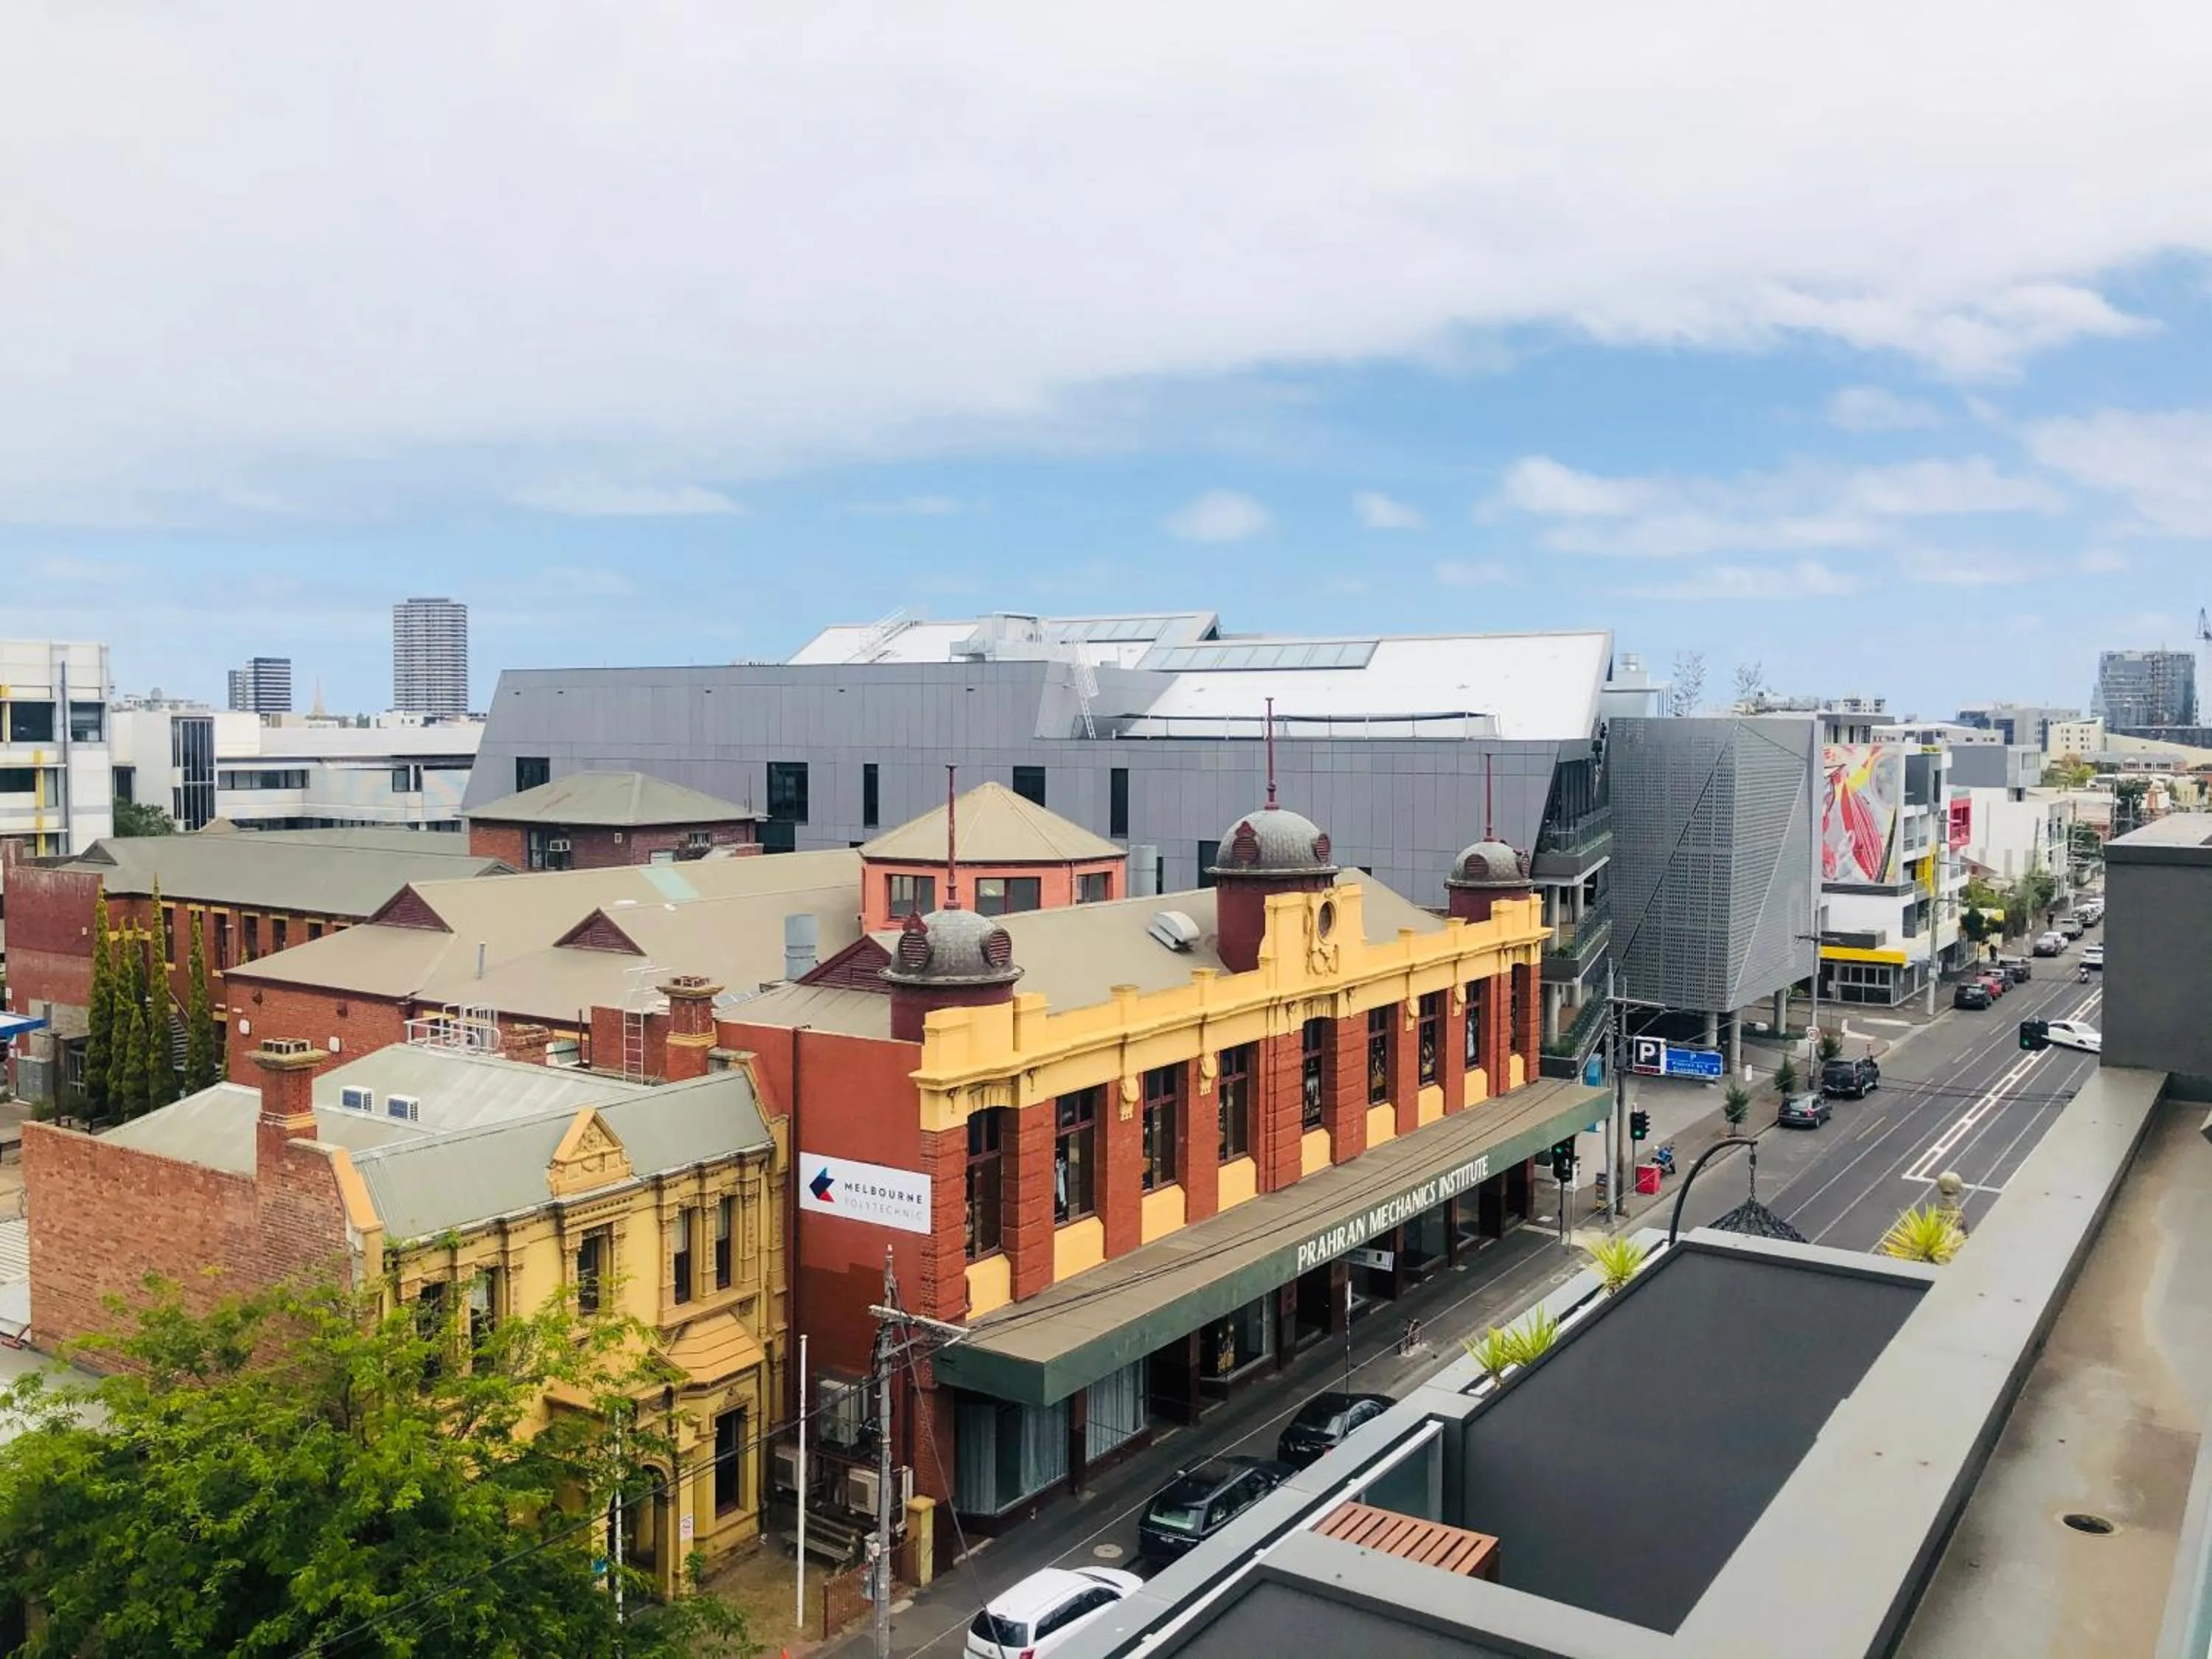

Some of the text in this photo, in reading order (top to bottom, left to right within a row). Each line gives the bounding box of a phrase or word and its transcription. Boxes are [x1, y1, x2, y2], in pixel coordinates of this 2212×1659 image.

[1639, 1042, 1655, 1062] P
[844, 1182, 923, 1204] MELBOURNE
[844, 1197, 923, 1221] POLYTECHNIC
[1298, 1155, 1489, 1271] PRAHRAN MECHANICS INSTITUTE
